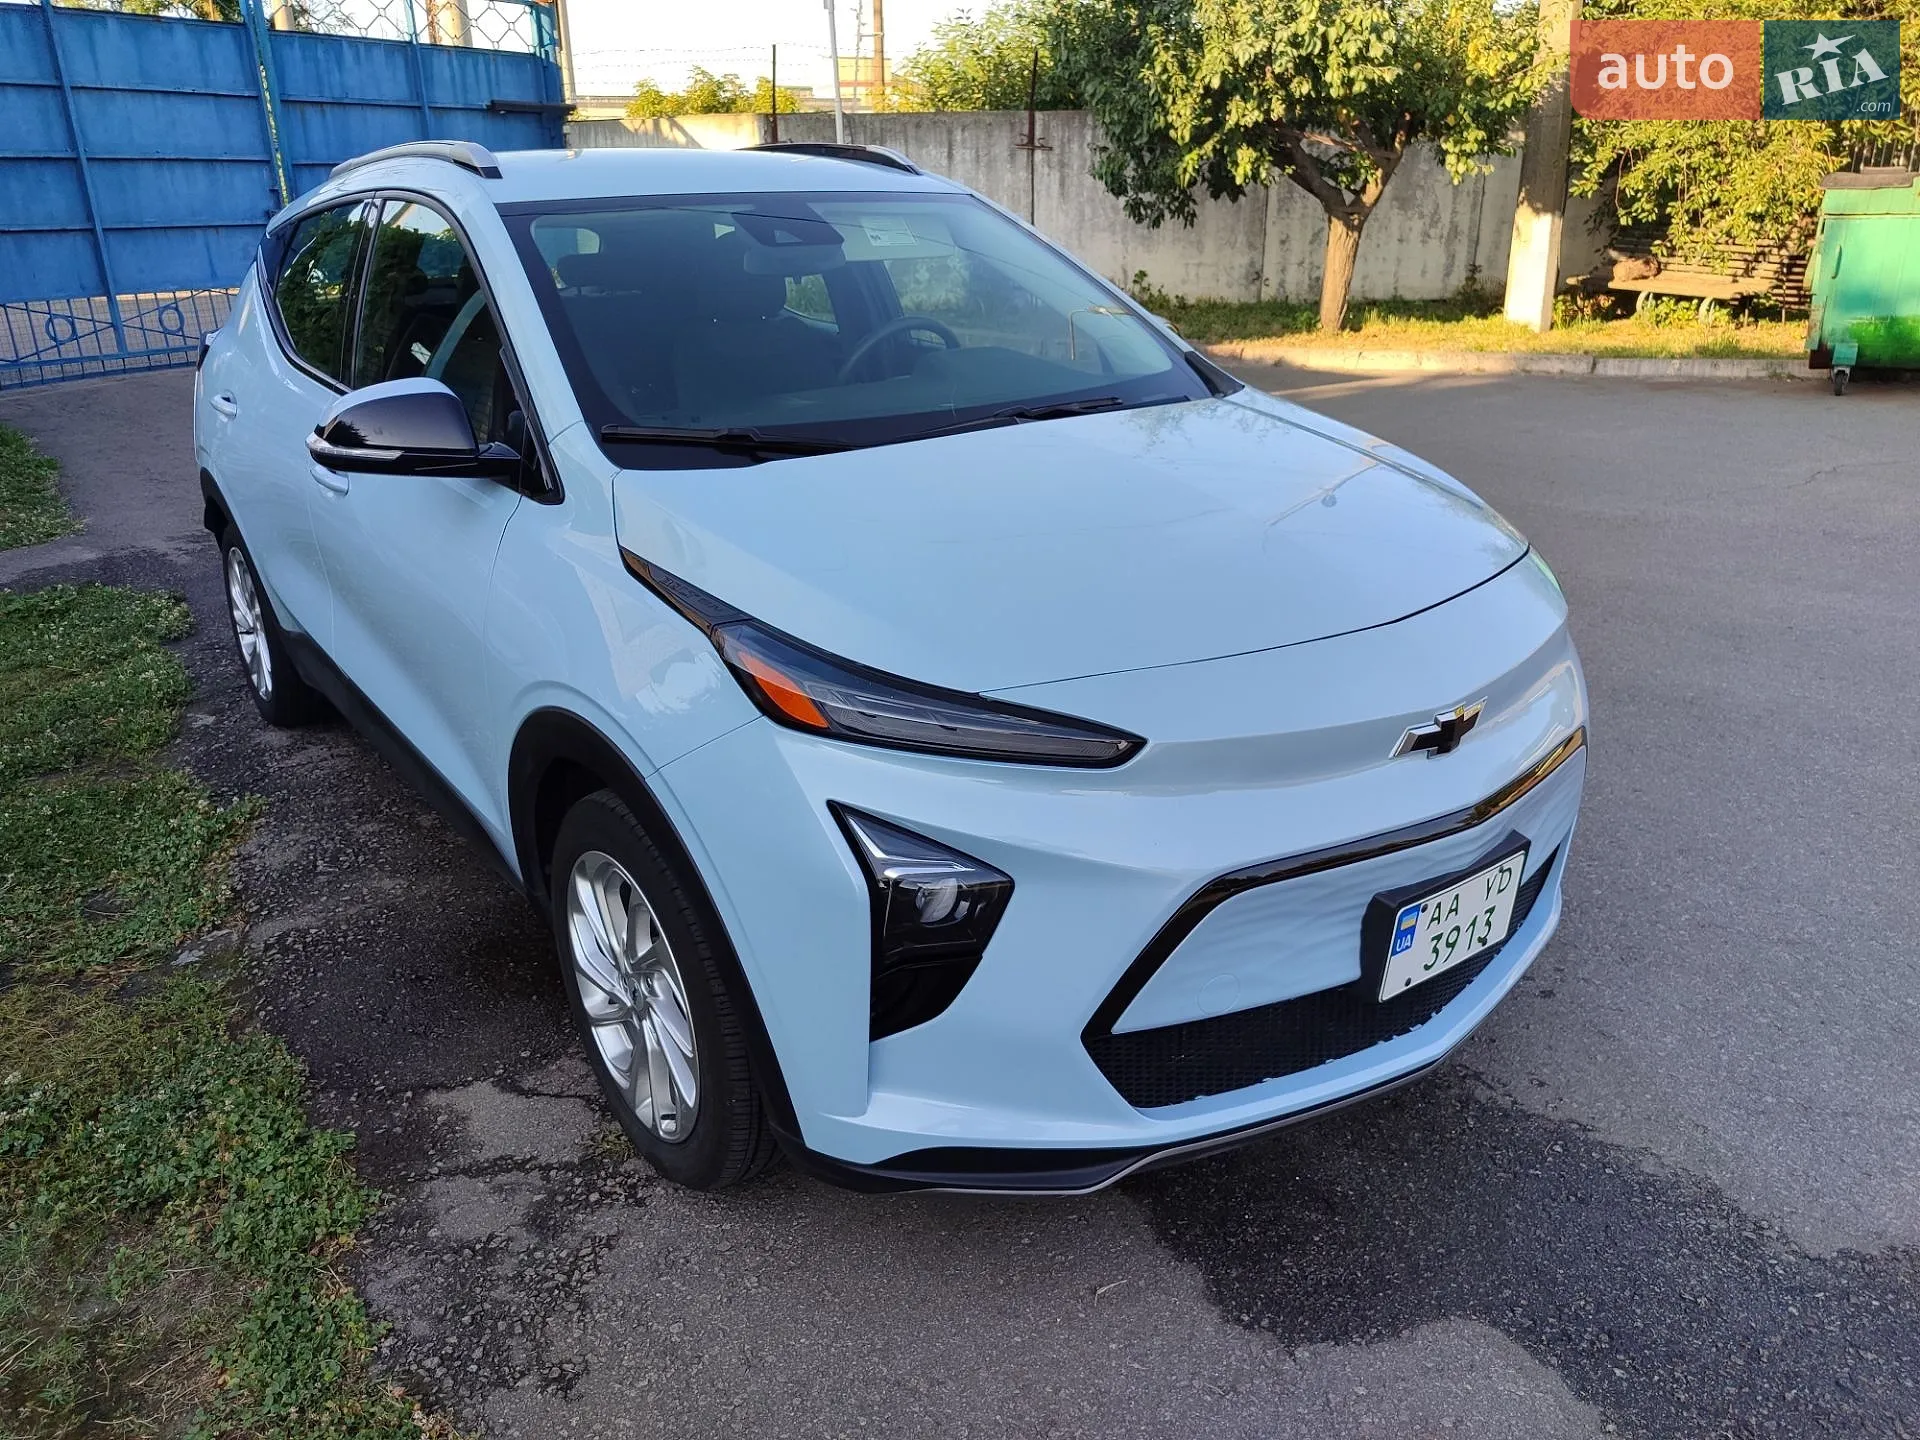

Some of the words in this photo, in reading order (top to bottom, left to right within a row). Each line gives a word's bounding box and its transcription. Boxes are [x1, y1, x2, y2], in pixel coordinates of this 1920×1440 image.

[1425, 893, 1460, 931] AA
[1485, 866, 1512, 901] YD
[1395, 934, 1412, 952] UA
[1423, 905, 1497, 971] 3913
